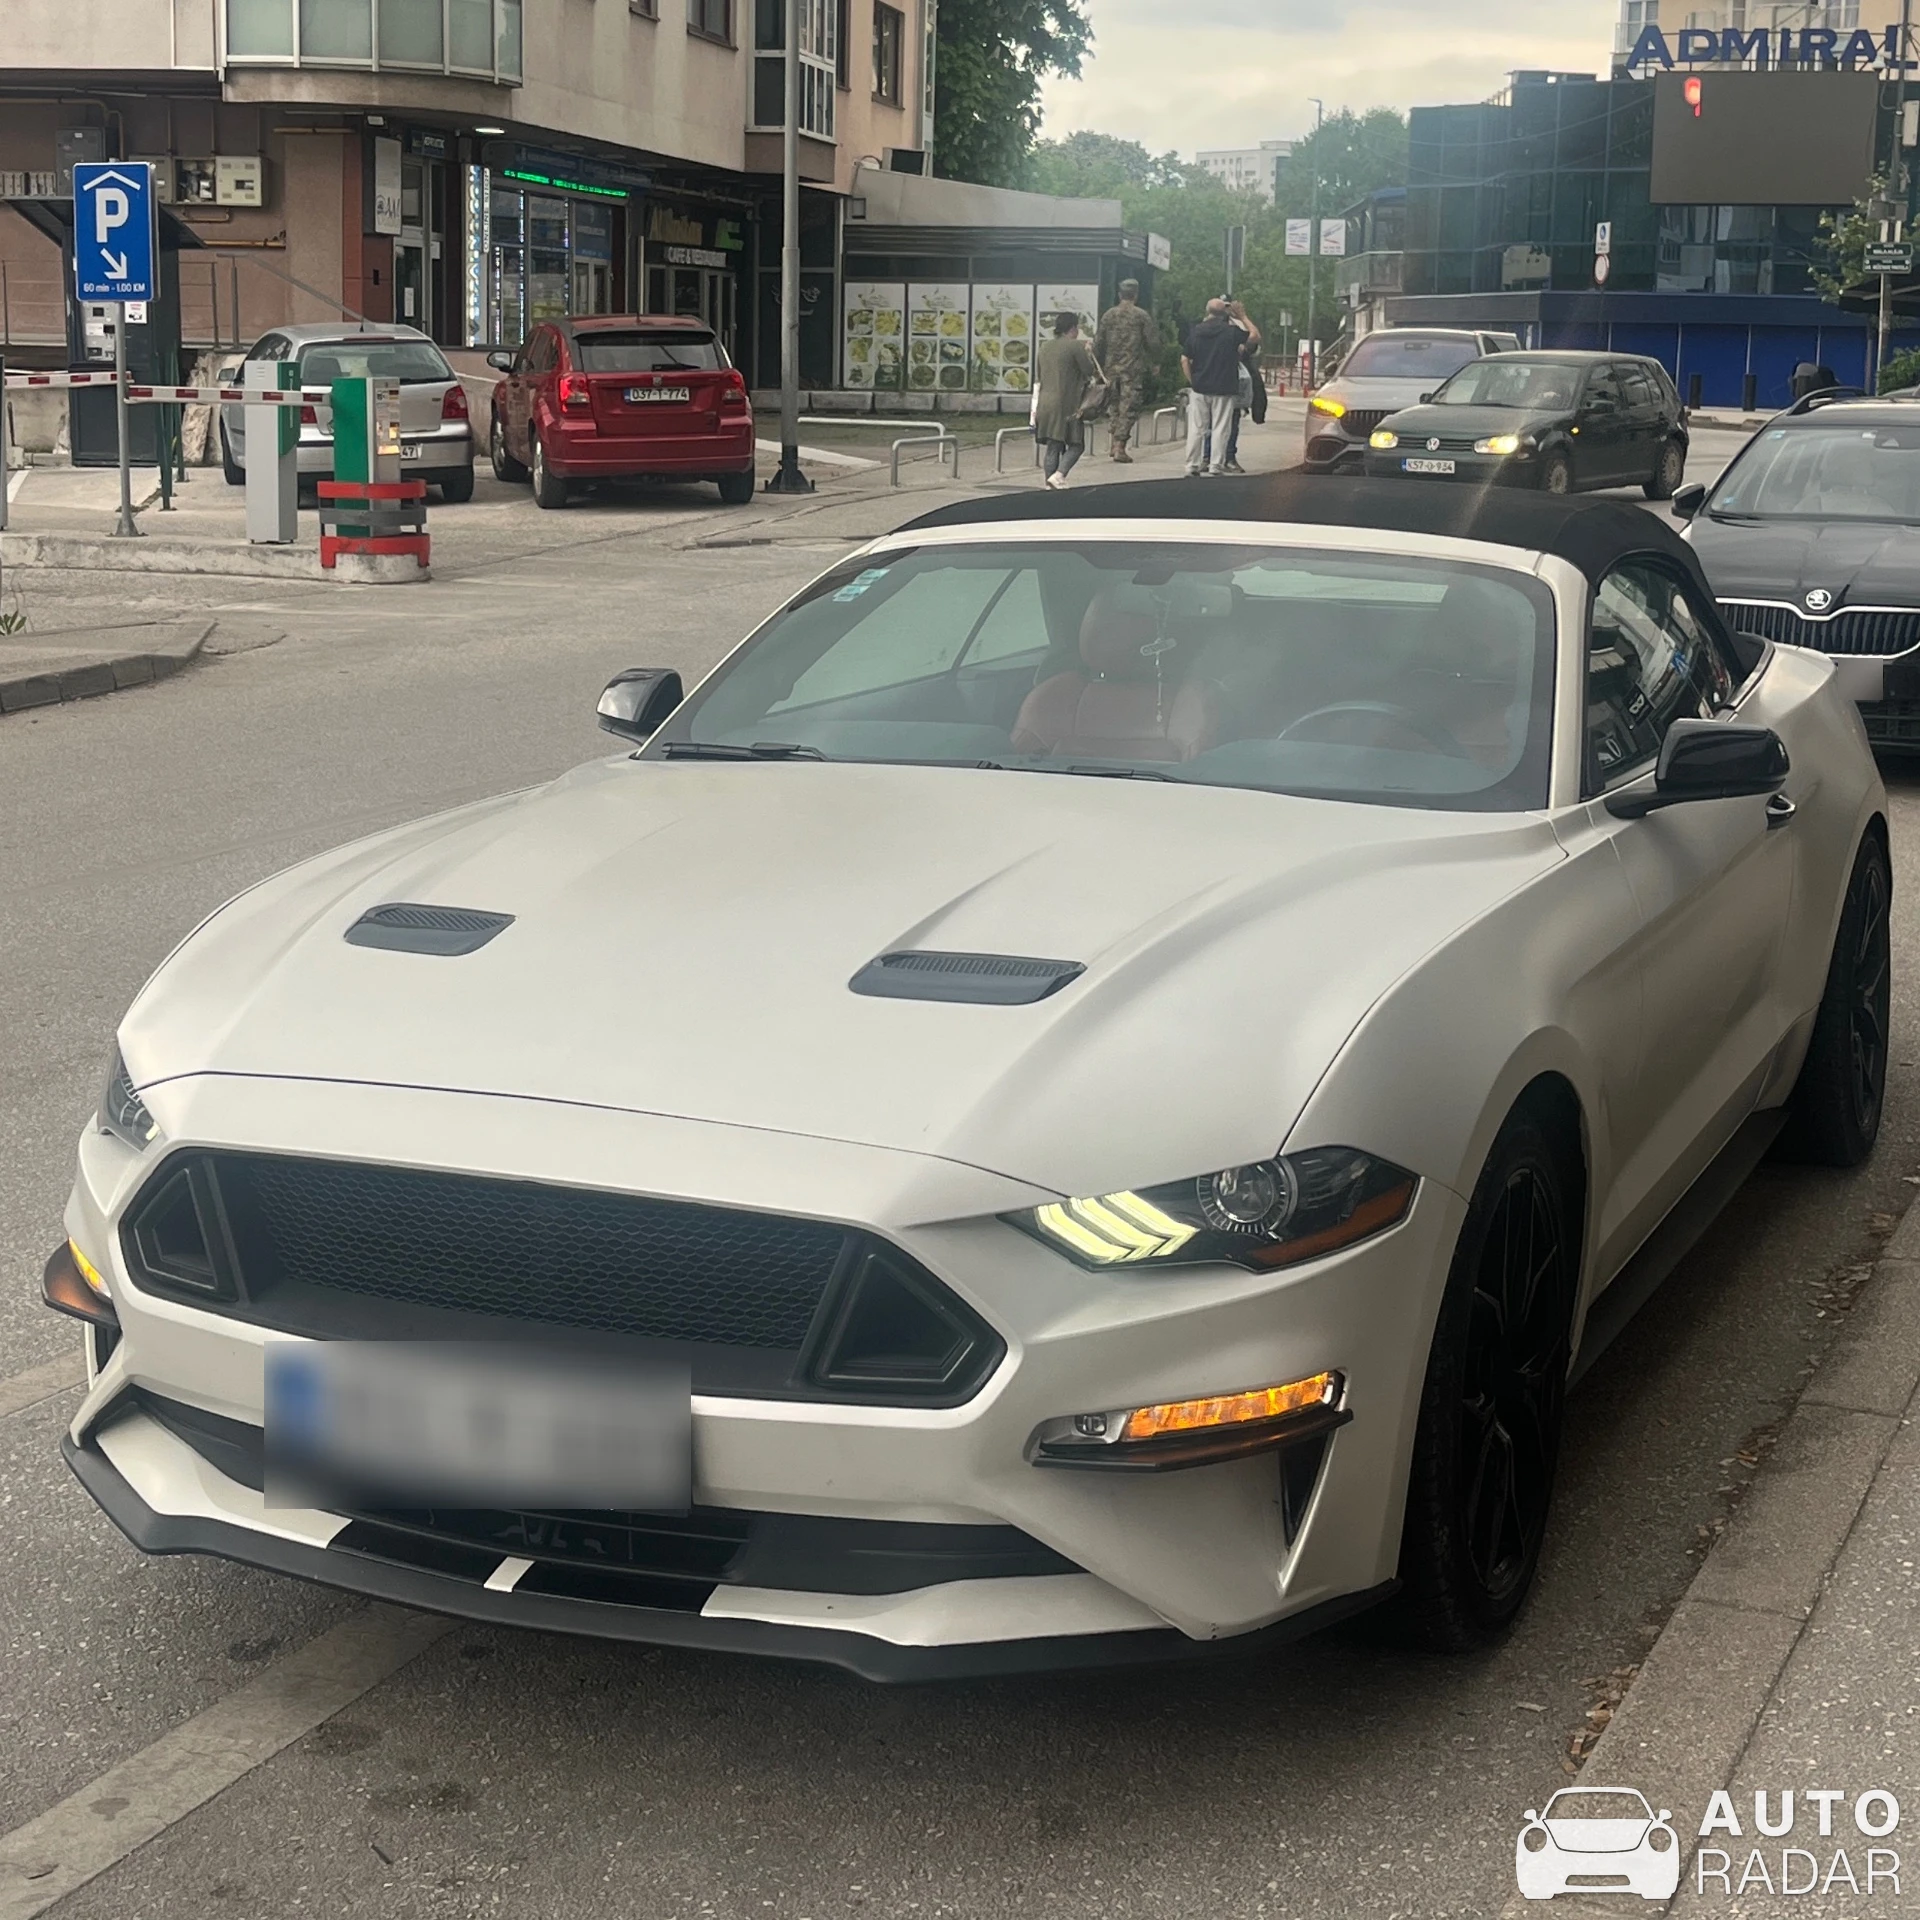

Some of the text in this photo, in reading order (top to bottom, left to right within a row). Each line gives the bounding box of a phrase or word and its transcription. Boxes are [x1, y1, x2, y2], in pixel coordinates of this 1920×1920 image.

[1626, 24, 1919, 70] ADMIRAL
[95, 188, 129, 243] P
[83, 282, 95, 293] 60
[132, 282, 146, 293] KM
